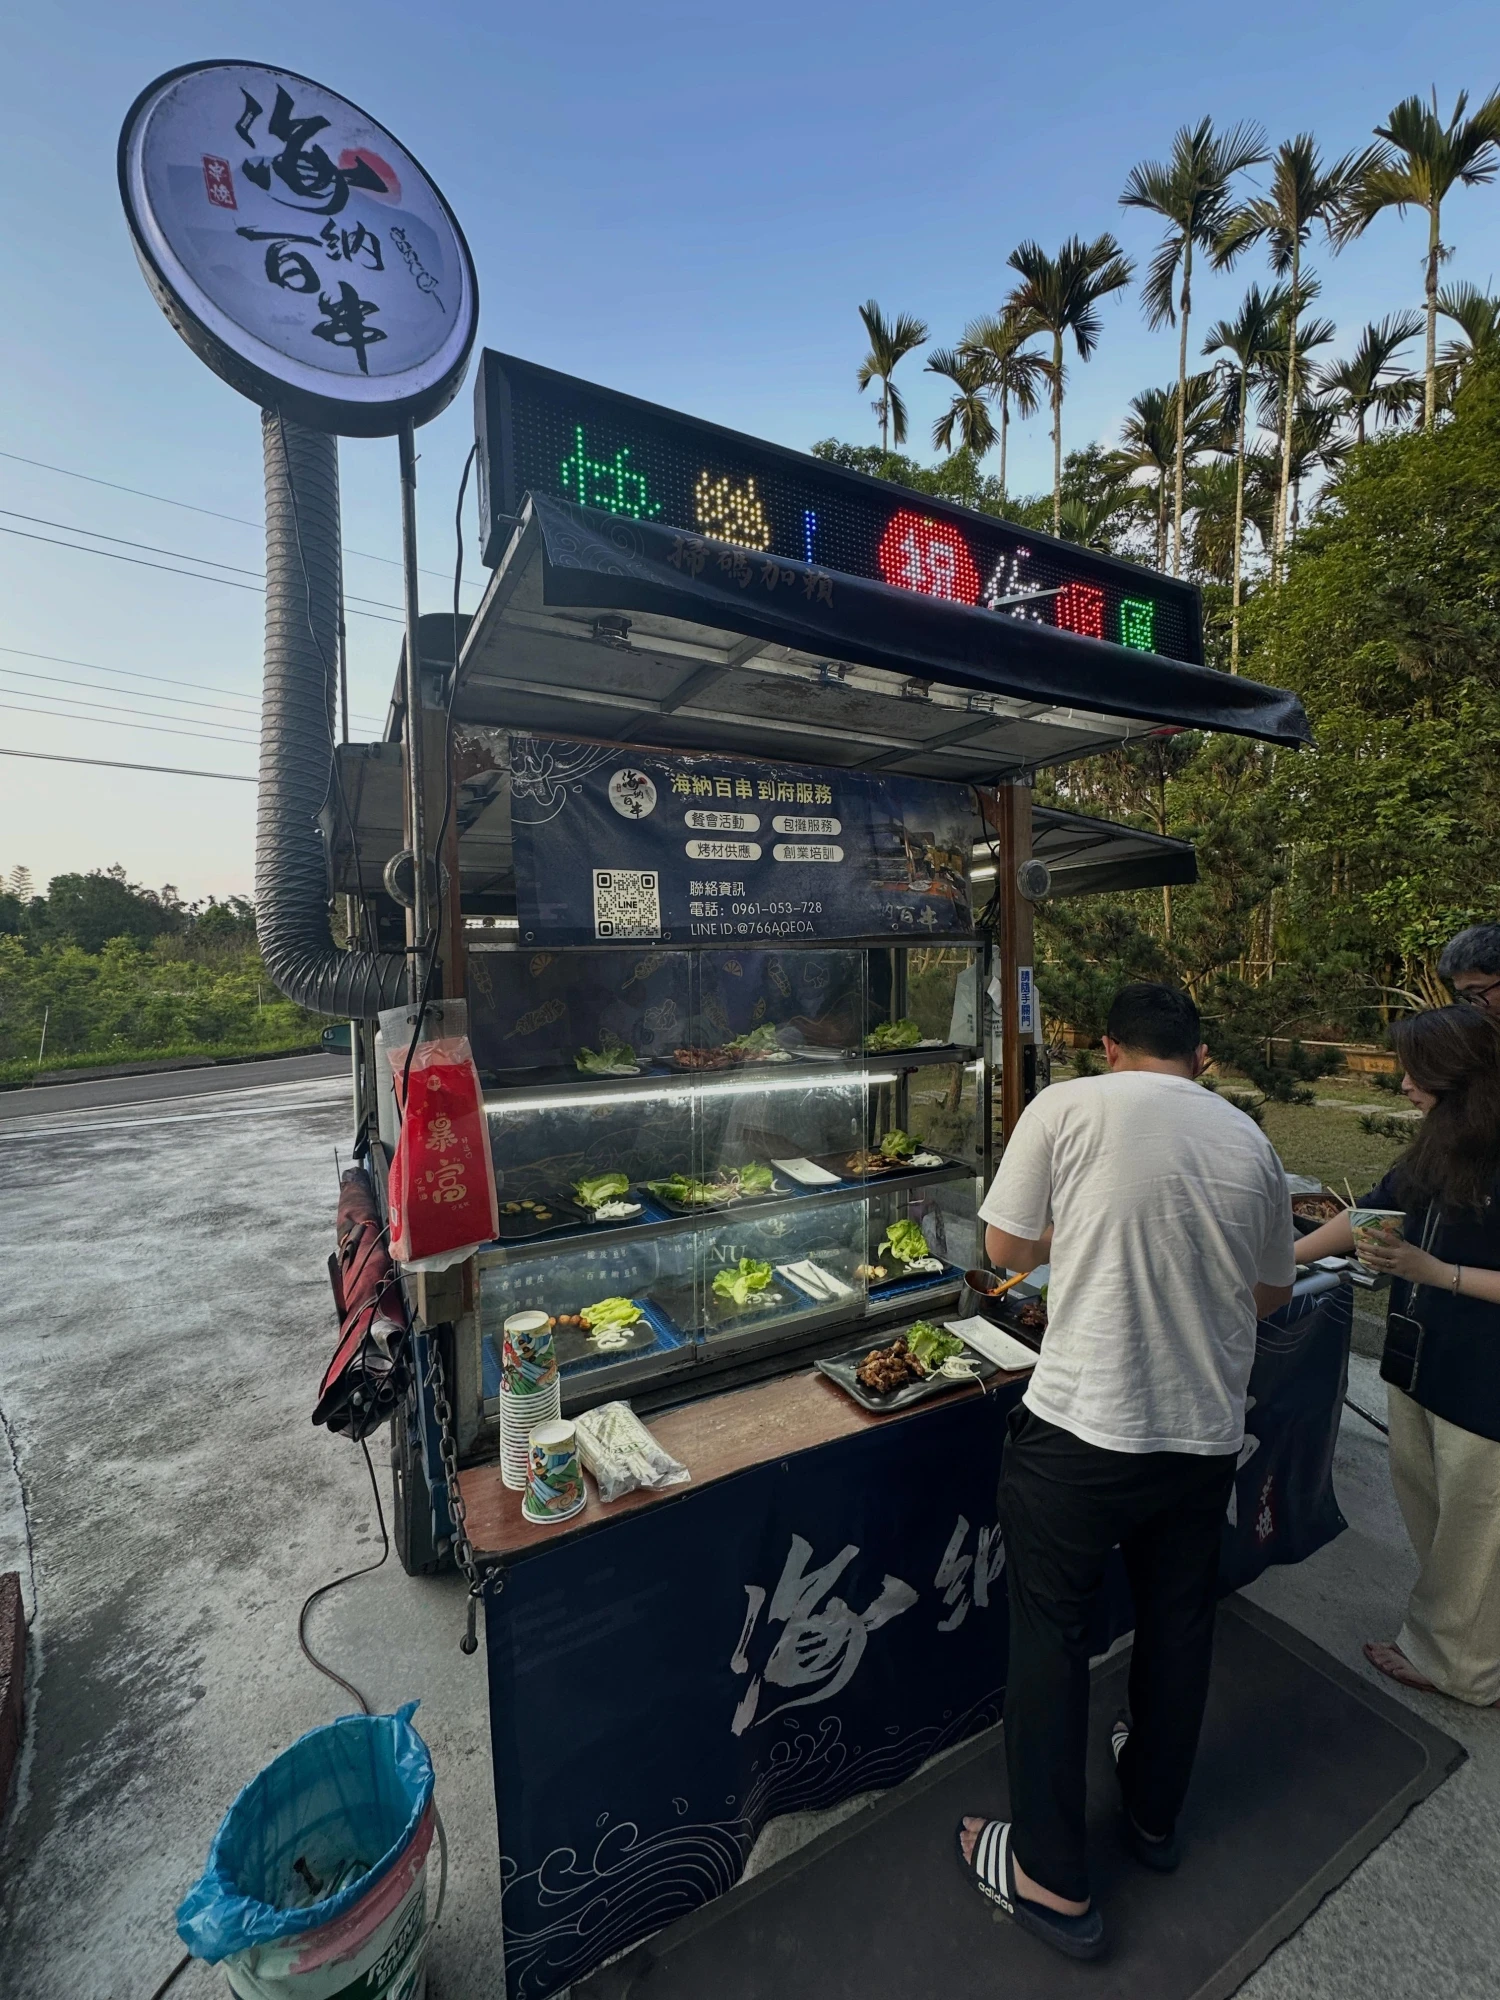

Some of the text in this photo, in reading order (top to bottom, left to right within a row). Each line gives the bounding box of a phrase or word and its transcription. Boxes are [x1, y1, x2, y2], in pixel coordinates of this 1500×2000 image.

[667, 533, 834, 609] 掃碼加賴
[671, 773, 833, 805] 海納百串 到府服務
[692, 812, 745, 830] 餐會活動
[783, 817, 833, 833] 包攤服務
[697, 841, 751, 859] 烤材供應
[783, 845, 835, 861] 創業培訓
[689, 880, 746, 897] 聯絡資訊
[618, 901, 638, 909] LINE
[731, 901, 823, 915] 0961-053-728
[690, 923, 718, 936] LINE
[978, 1882, 1014, 1914] adidas
